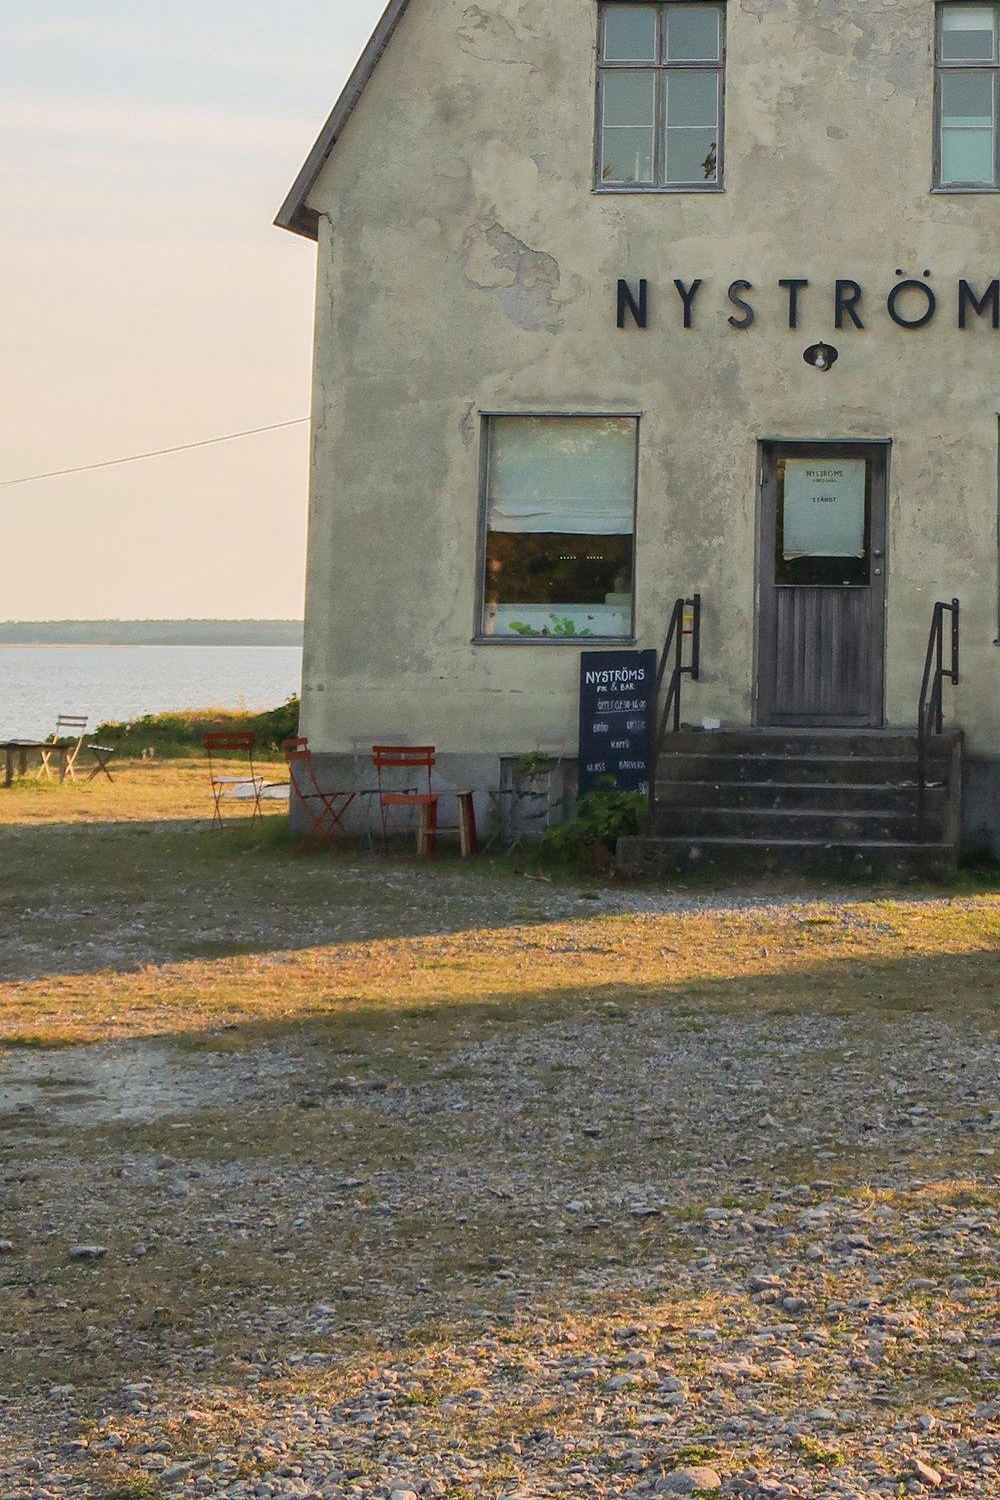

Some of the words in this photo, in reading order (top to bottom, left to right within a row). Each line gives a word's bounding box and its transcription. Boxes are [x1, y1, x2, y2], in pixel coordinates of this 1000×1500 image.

[585, 667, 645, 684] NYSTRÖMS
[610, 681, 618, 692] &
[620, 682, 635, 692] BAR
